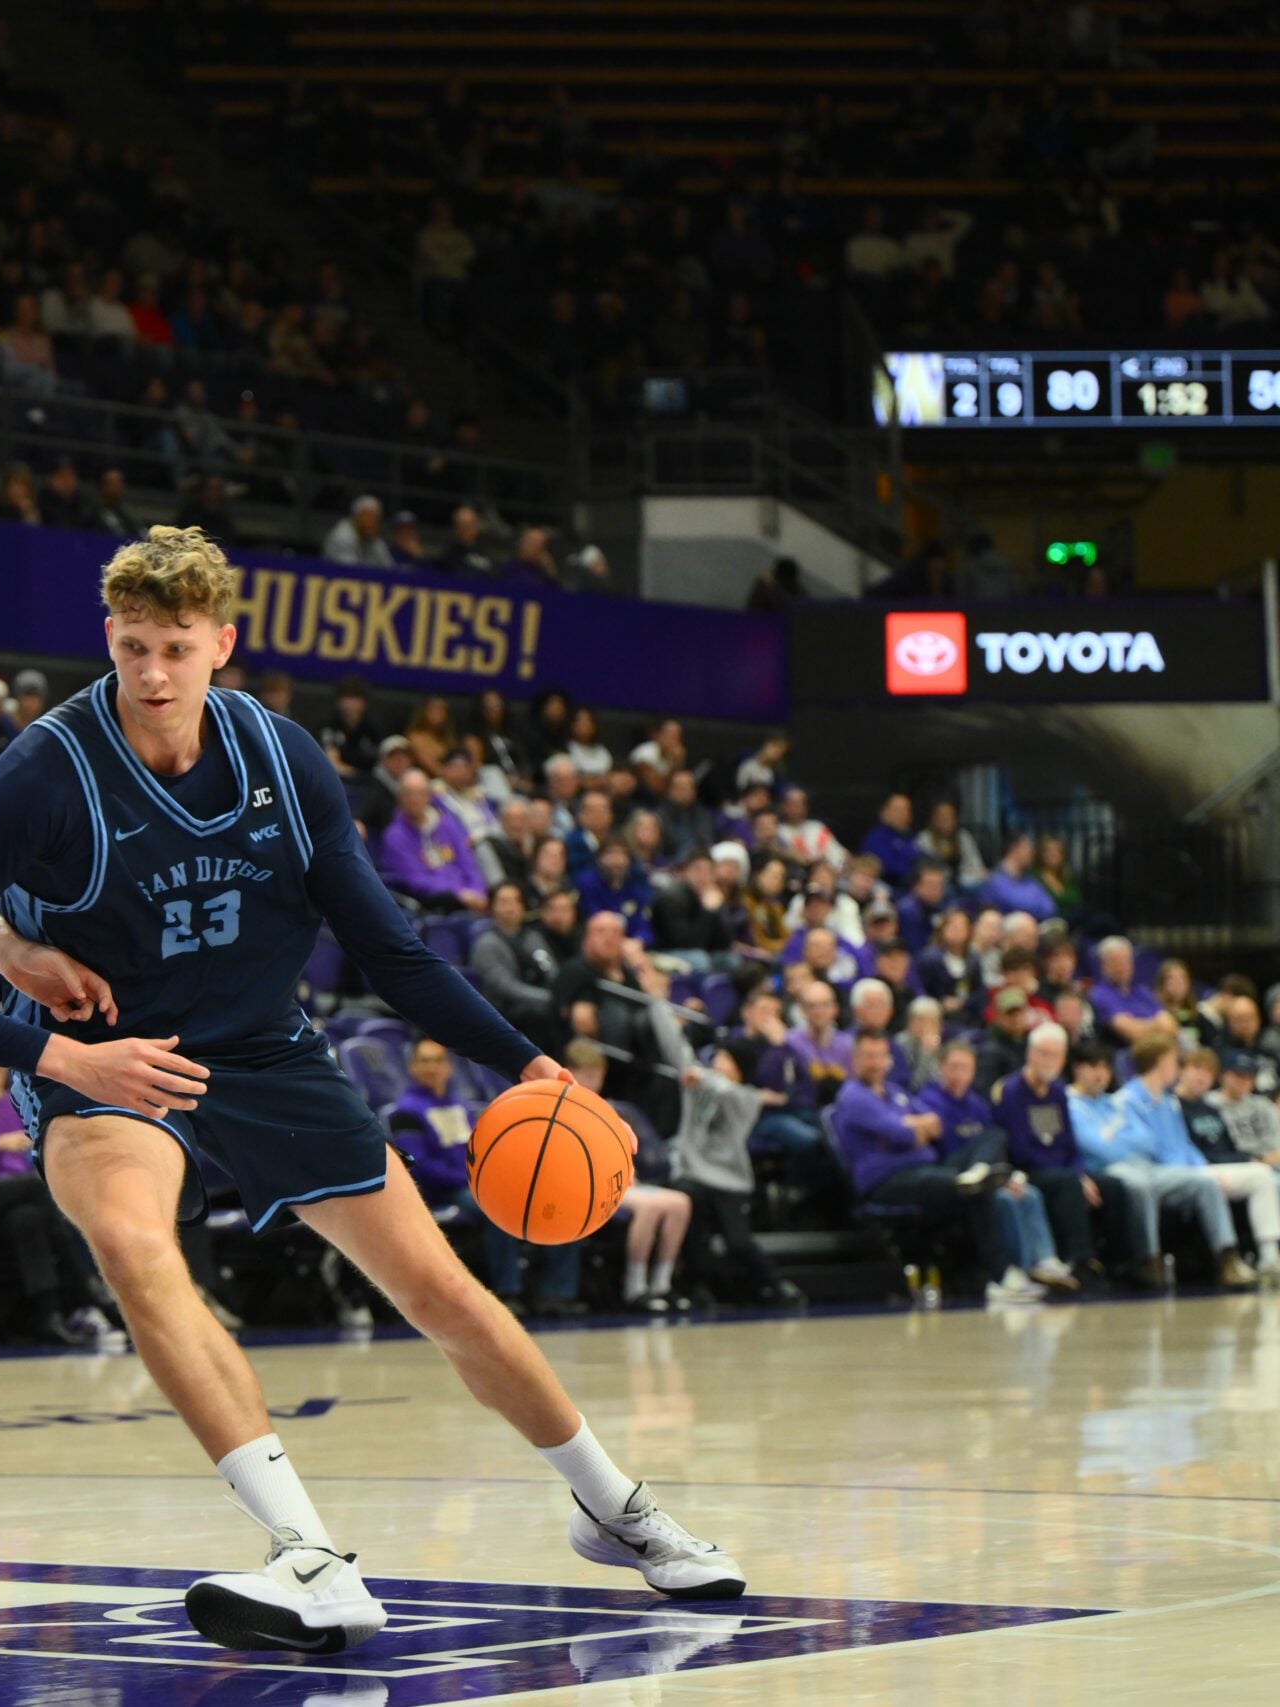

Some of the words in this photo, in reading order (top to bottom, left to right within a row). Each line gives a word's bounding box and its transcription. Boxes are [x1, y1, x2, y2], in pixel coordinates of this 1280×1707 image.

[952, 382, 978, 417] 2
[1047, 369, 1099, 411] 80
[1137, 382, 1209, 416] 1:52
[230, 564, 543, 681] HUSKIES!
[976, 631, 1165, 674] TOYOTA
[252, 787, 273, 808] JC
[195, 855, 273, 882] DIEGO
[160, 889, 242, 961] 23
